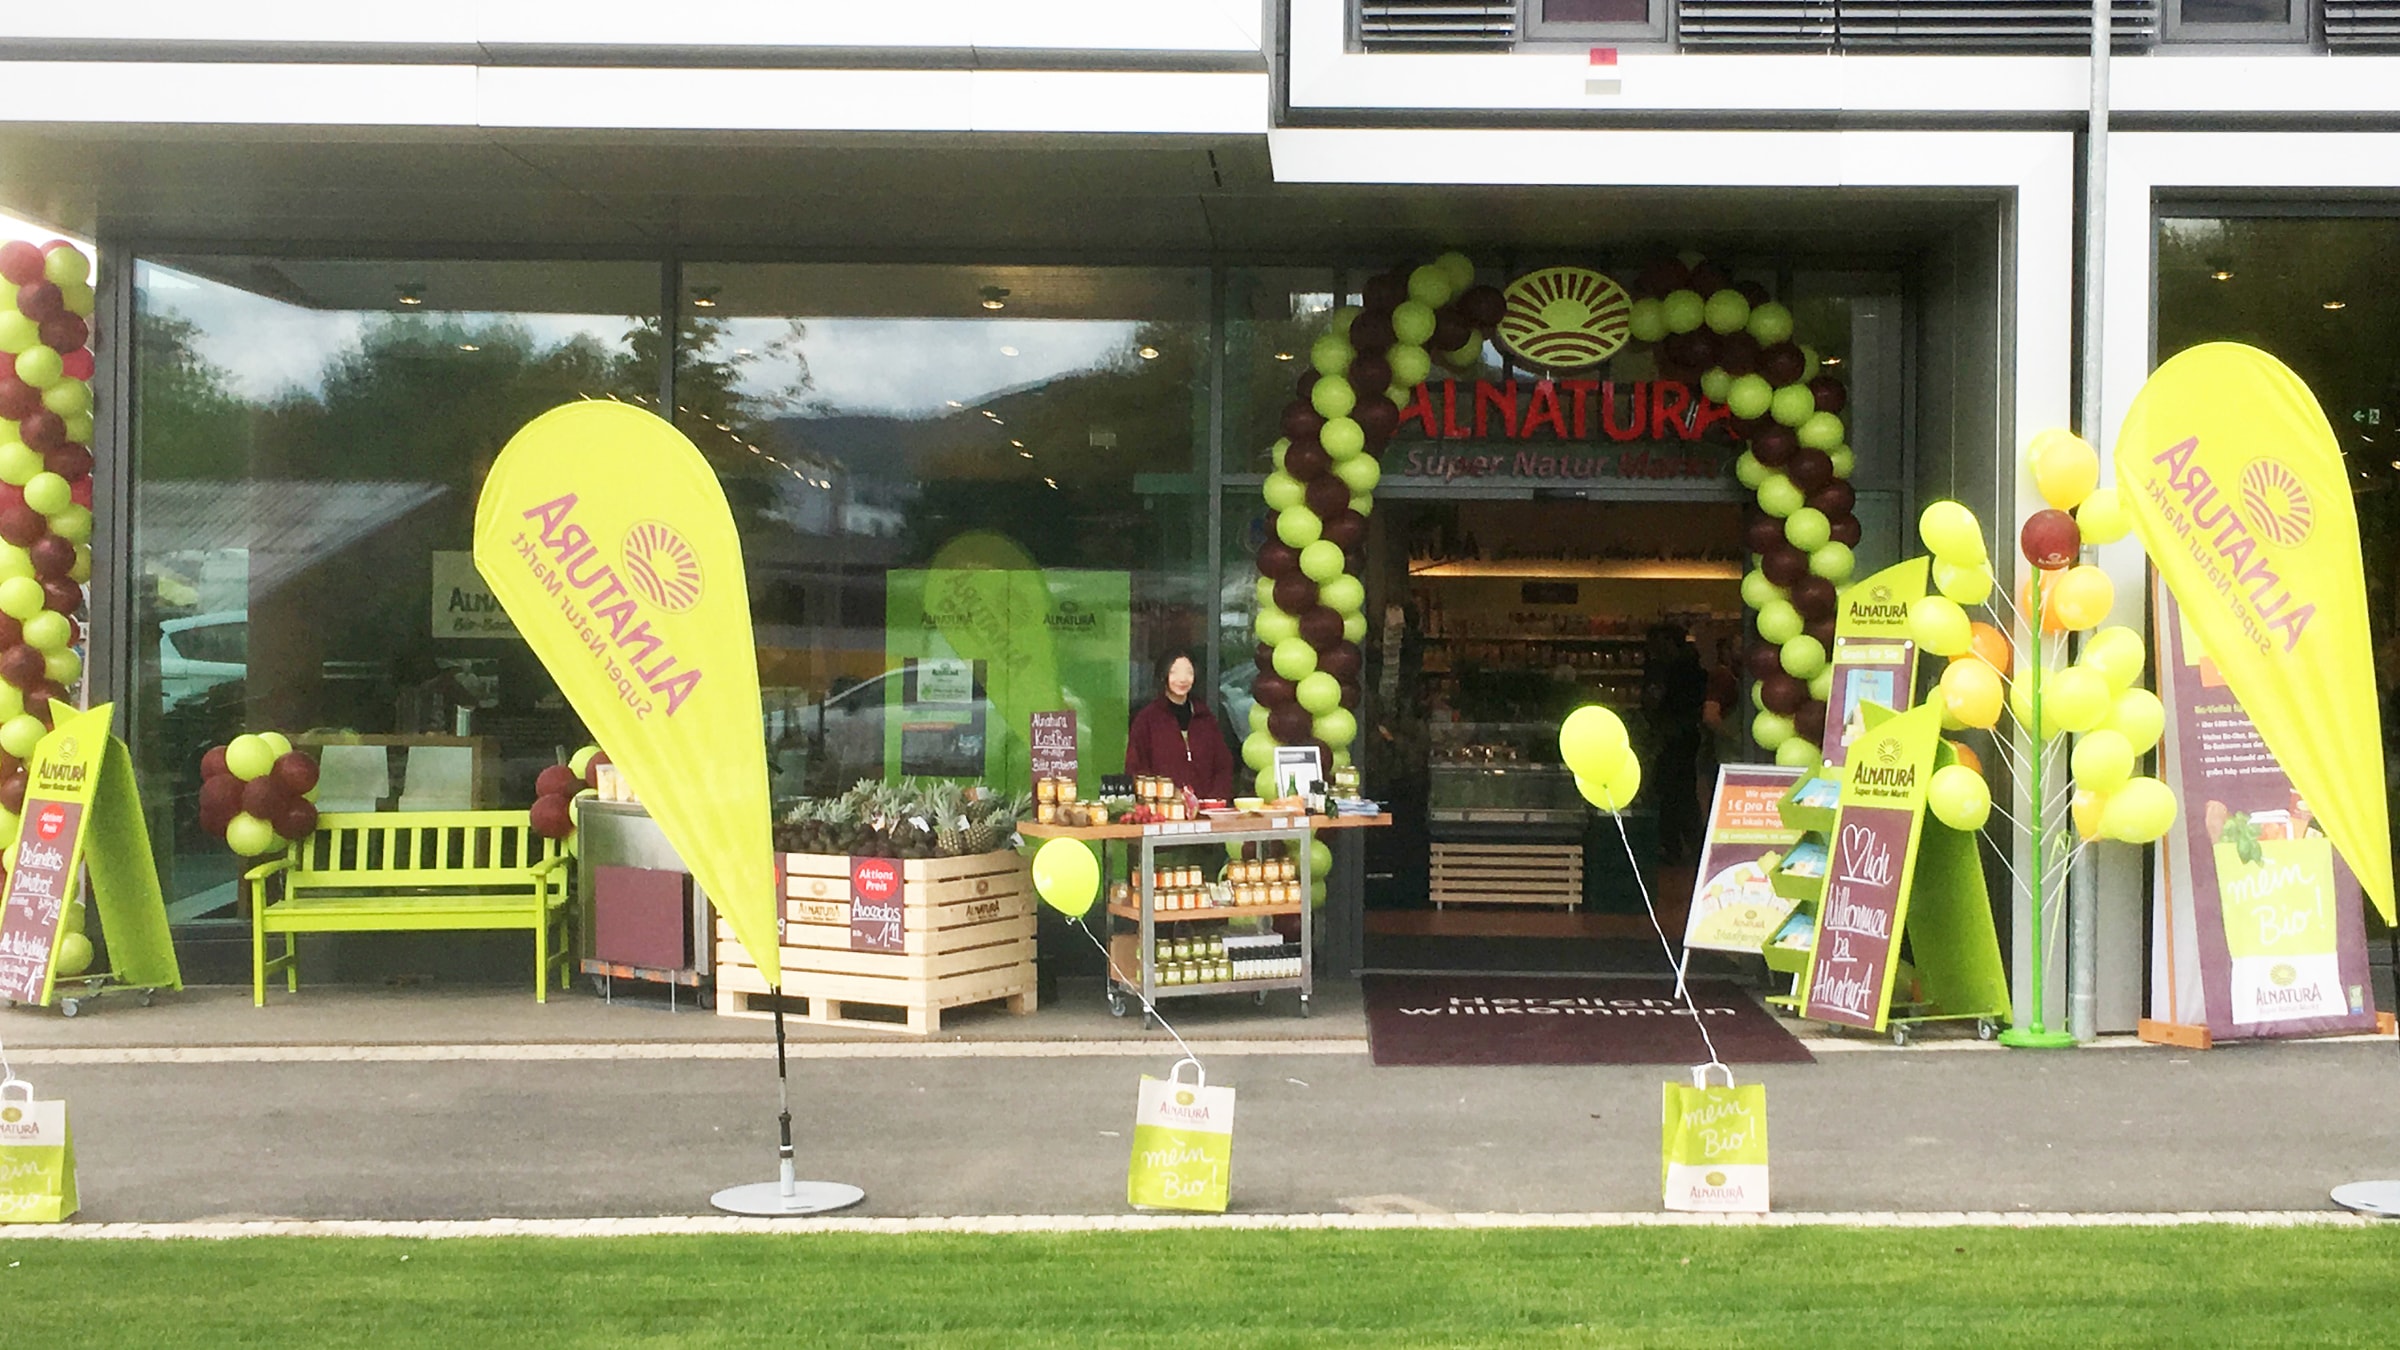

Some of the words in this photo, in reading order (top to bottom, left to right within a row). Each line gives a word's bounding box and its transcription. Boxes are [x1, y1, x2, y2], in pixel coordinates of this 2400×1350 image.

[1390, 378, 1739, 441] ALNATURA
[1405, 449, 1503, 483] Super
[1513, 450, 1609, 479] Natur
[1850, 601, 1908, 618] ALNATURA
[38, 758, 88, 782] ALNATURA
[1853, 760, 1915, 787] ALNATURA
[1854, 786, 1871, 796] Super
[1872, 787, 1889, 797] Natur
[1890, 788, 1909, 798] Markt
[1744, 801, 1763, 813] pro
[859, 869, 894, 881] Aktions
[865, 881, 888, 892] Preis
[2227, 856, 2315, 904] mein
[798, 903, 840, 918] ALNATURA
[852, 896, 901, 920] Avocados
[966, 900, 1000, 916] ALNATURA
[2252, 885, 2326, 946] Bio!
[1449, 996, 1673, 1007] Herzlich
[2256, 982, 2323, 1006] ALNATURA
[1160, 1101, 1210, 1120] ALNATURA
[1683, 1092, 1752, 1130] mein
[1698, 1115, 1758, 1159] Bio!
[1141, 1135, 1215, 1169] mein
[1160, 1165, 1218, 1200] Bio!
[1690, 1186, 1744, 1199] ALNATURA
